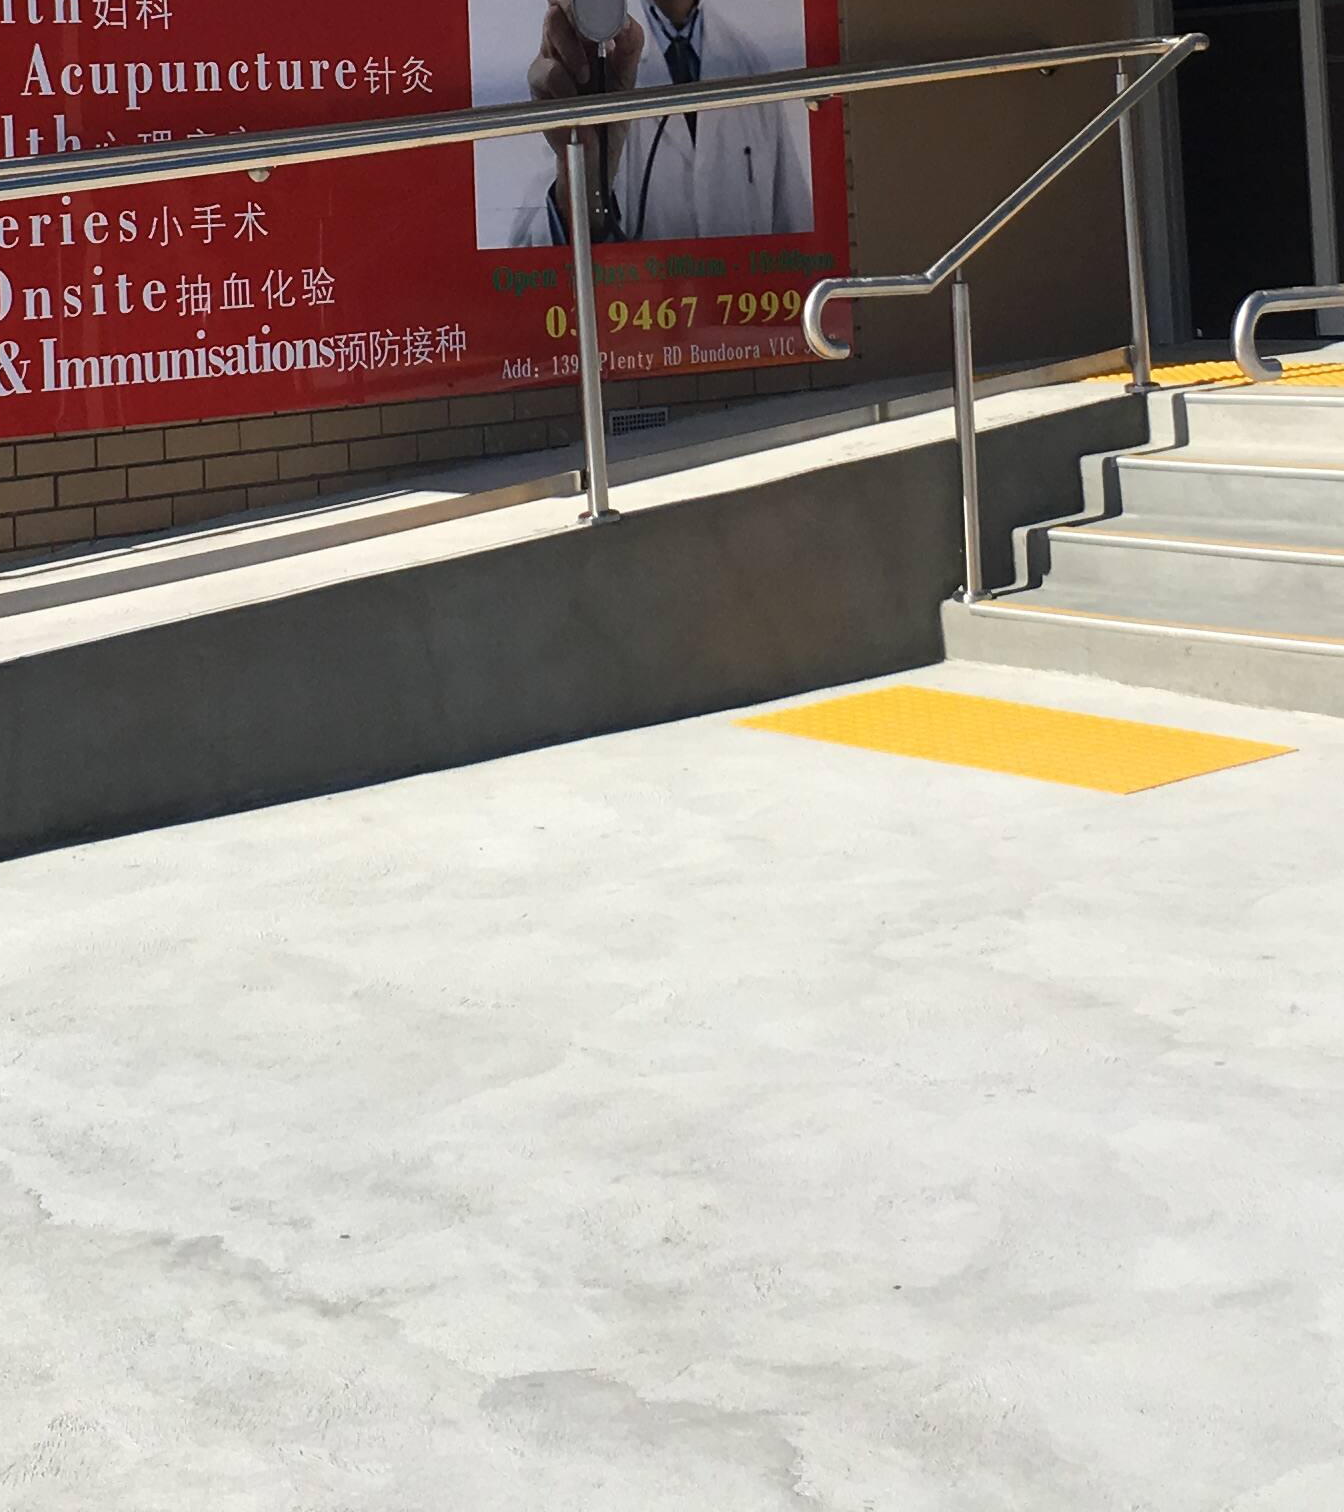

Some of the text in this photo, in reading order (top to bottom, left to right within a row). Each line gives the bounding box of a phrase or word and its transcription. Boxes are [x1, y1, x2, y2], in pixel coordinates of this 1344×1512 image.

[20, 42, 358, 111] Acupuncture
[363, 55, 435, 96] 针灸
[148, 200, 270, 248] 小手术
[175, 265, 336, 318] 抽血化验
[492, 265, 557, 296] Open
[608, 294, 698, 334] 9467
[716, 290, 802, 326] 7999
[40, 324, 336, 393] Immunisations
[334, 323, 467, 374] 预防接种
[599, 349, 655, 372] Plenty
[663, 346, 683, 367] RD
[690, 340, 762, 364] Bundoora
[768, 335, 796, 357] VIC
